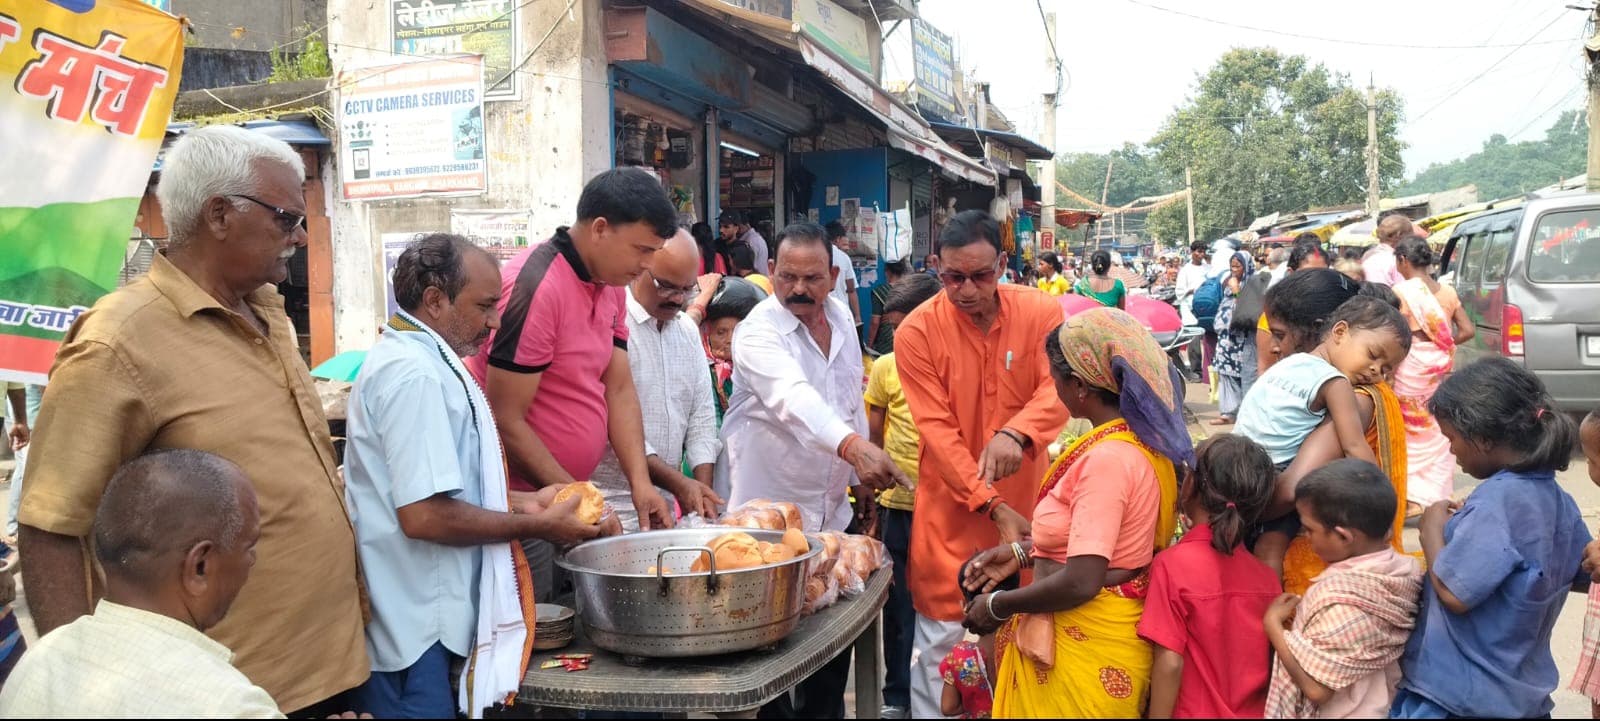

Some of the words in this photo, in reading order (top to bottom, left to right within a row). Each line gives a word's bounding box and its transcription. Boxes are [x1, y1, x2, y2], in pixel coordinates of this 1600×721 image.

[18, 29, 168, 138] मंच
[344, 100, 374, 116] CCTV
[375, 93, 420, 113] CAMERA
[421, 88, 476, 108] SERVICES
